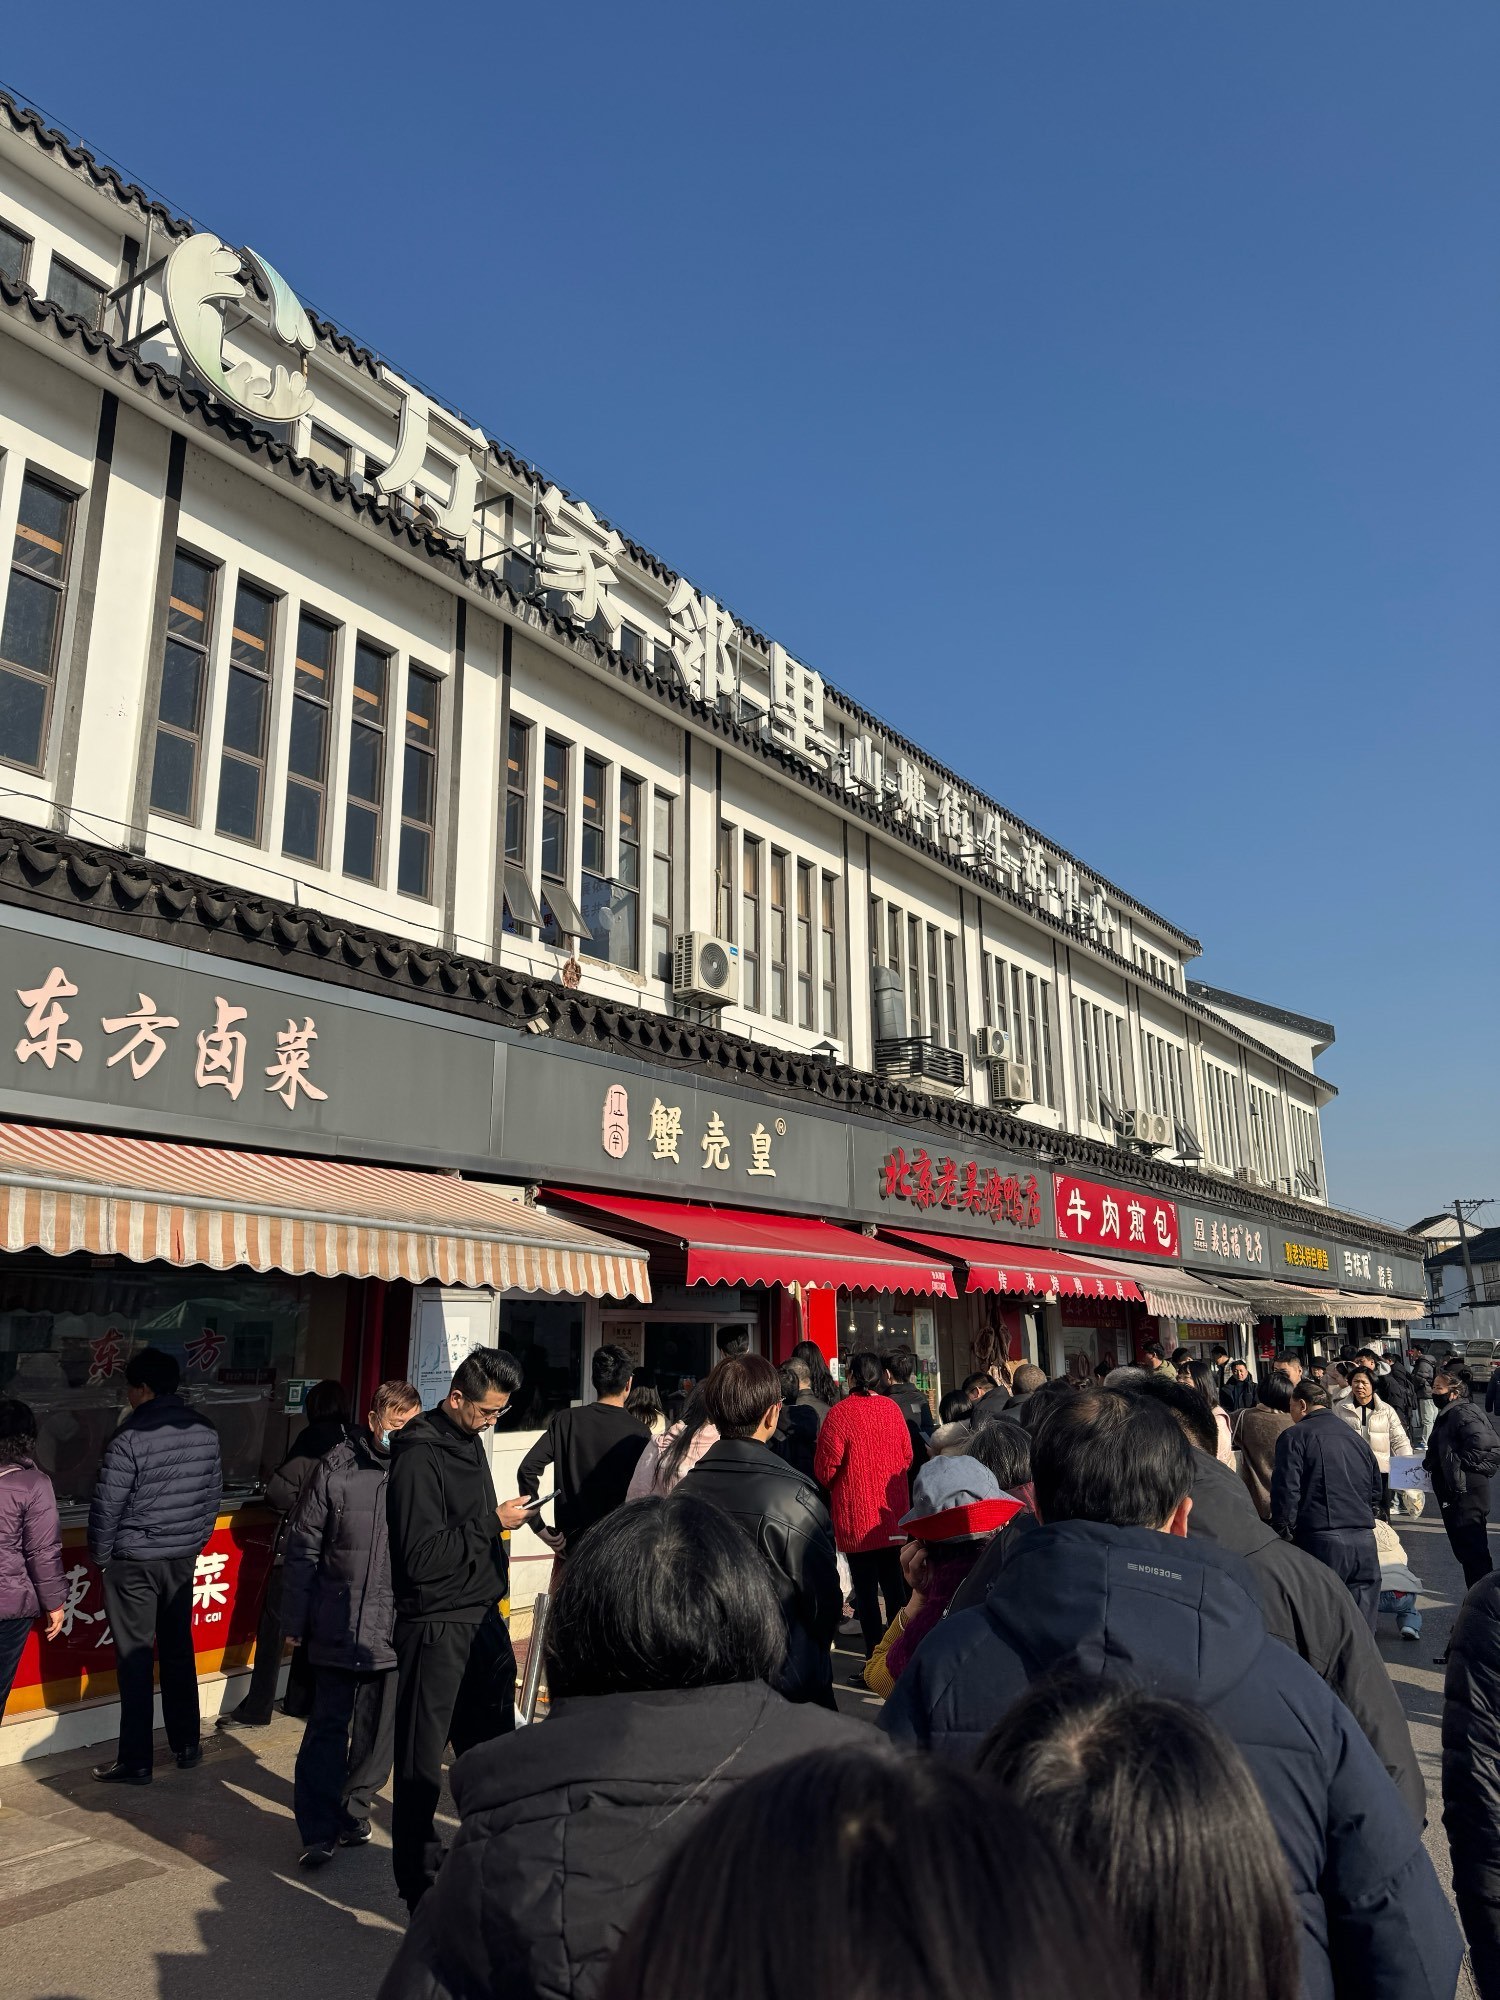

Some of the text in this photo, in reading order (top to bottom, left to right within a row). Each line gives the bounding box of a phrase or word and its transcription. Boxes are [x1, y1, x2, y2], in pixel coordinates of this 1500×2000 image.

[15, 967, 328, 1110] 东方卤菜
[882, 1146, 1041, 1228] 北京老吴烤鸭店
[1066, 1188, 1171, 1248] 牛肉煎包
[1139, 1564, 1171, 1579] DESIGN
